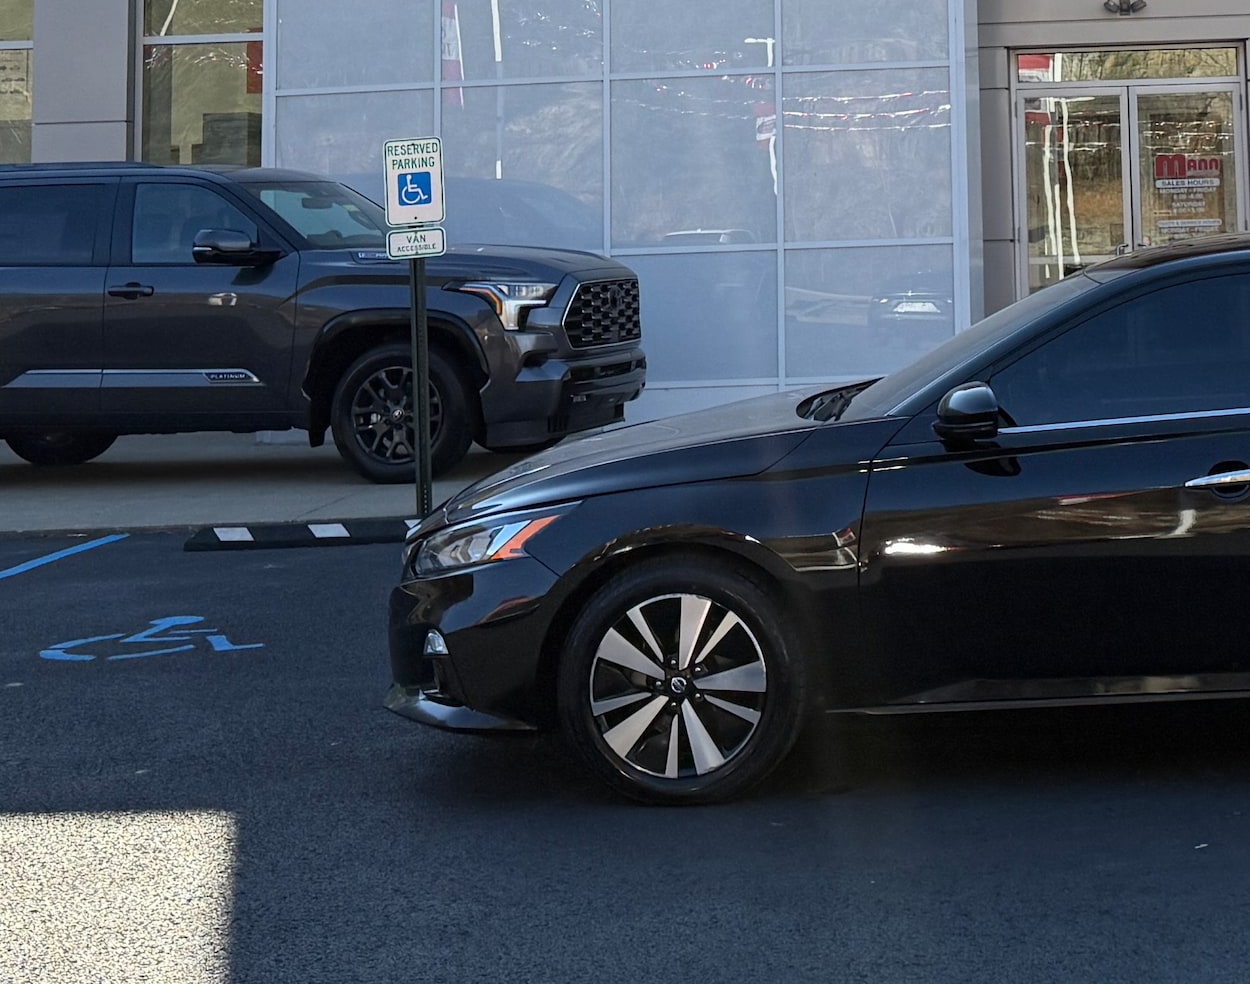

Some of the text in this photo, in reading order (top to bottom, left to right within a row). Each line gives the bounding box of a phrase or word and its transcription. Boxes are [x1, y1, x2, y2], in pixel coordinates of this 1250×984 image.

[387, 142, 438, 157] RESERVED
[392, 157, 435, 170] PARKING
[406, 234, 426, 244] VAN
[397, 243, 437, 253] ACCESSIBLE
